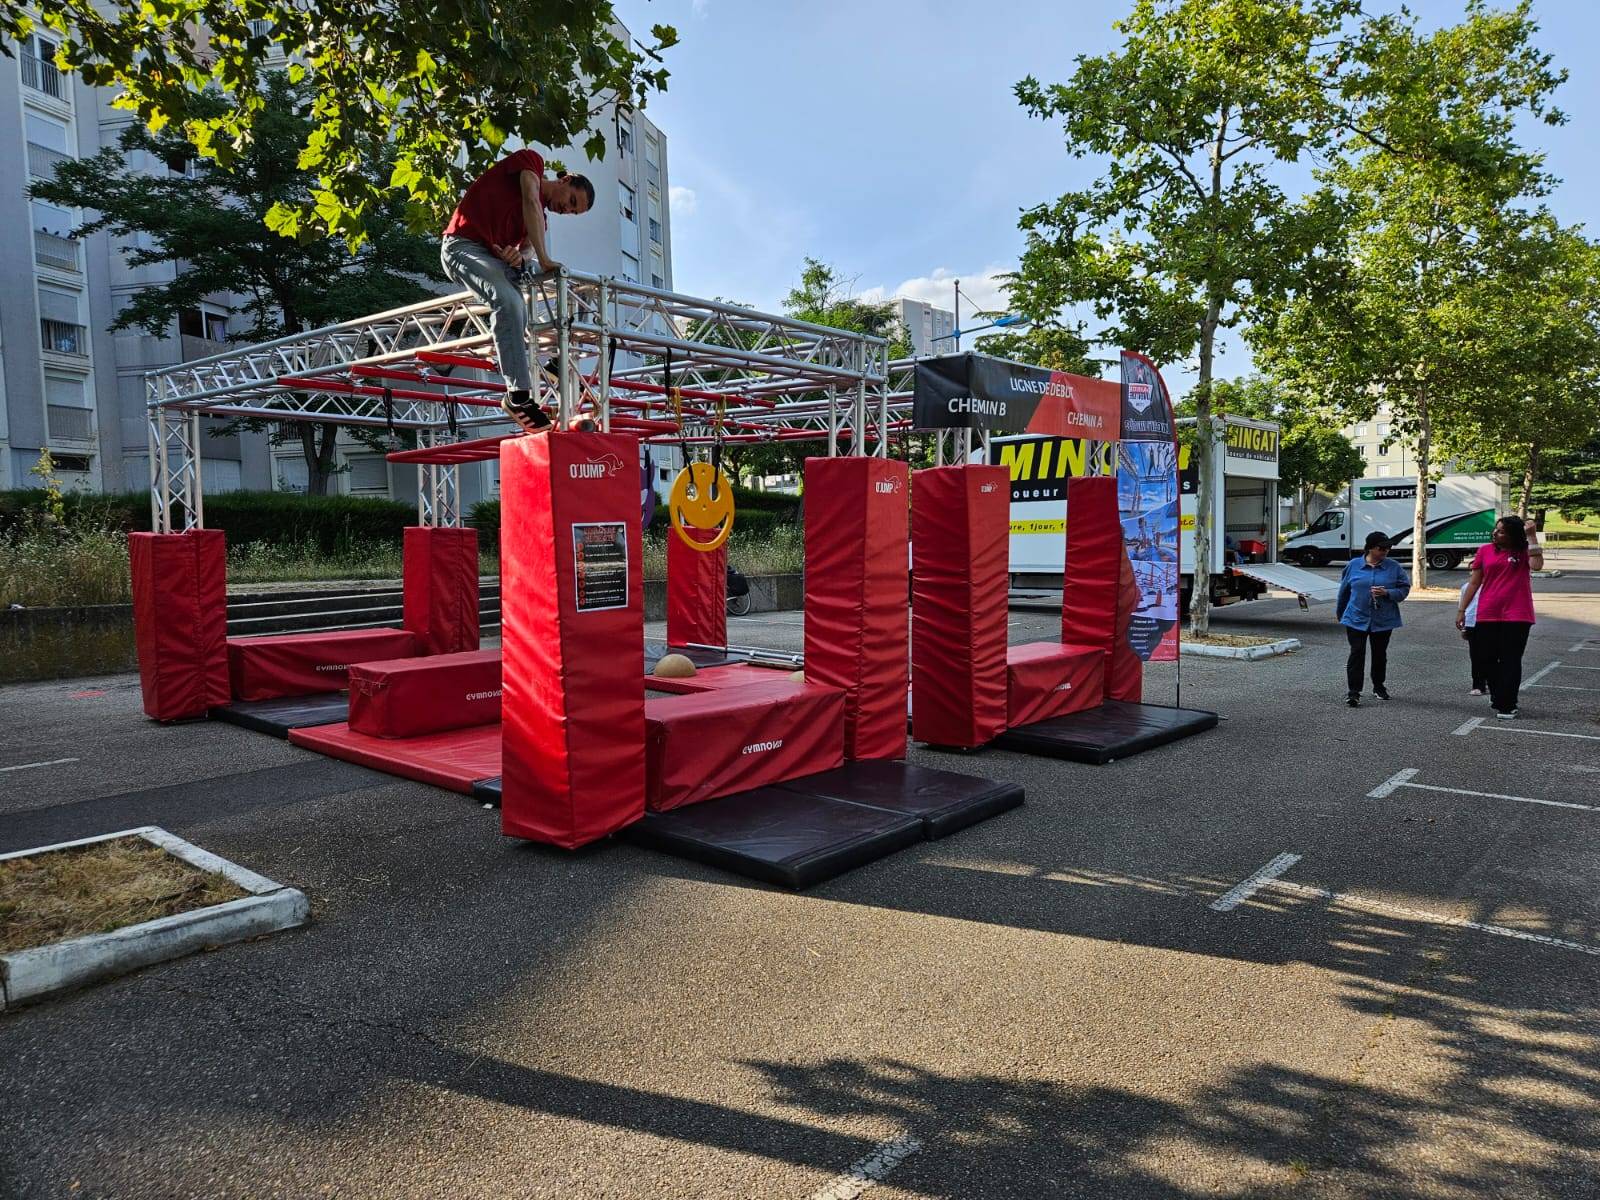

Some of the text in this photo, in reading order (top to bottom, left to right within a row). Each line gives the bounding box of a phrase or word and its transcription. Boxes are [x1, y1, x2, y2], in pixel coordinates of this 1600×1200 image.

[1010, 377, 1039, 394] LIGNE
[1039, 381, 1051, 395] DE
[948, 397, 1007, 416] CHEMIN B
[1067, 411, 1103, 429] CHEMIN A
[569, 463, 606, 479] O'JUMP
[1013, 488, 1059, 499] oueur
[1360, 488, 1436, 498] enterpre
[315, 663, 350, 671] GYMNOV
